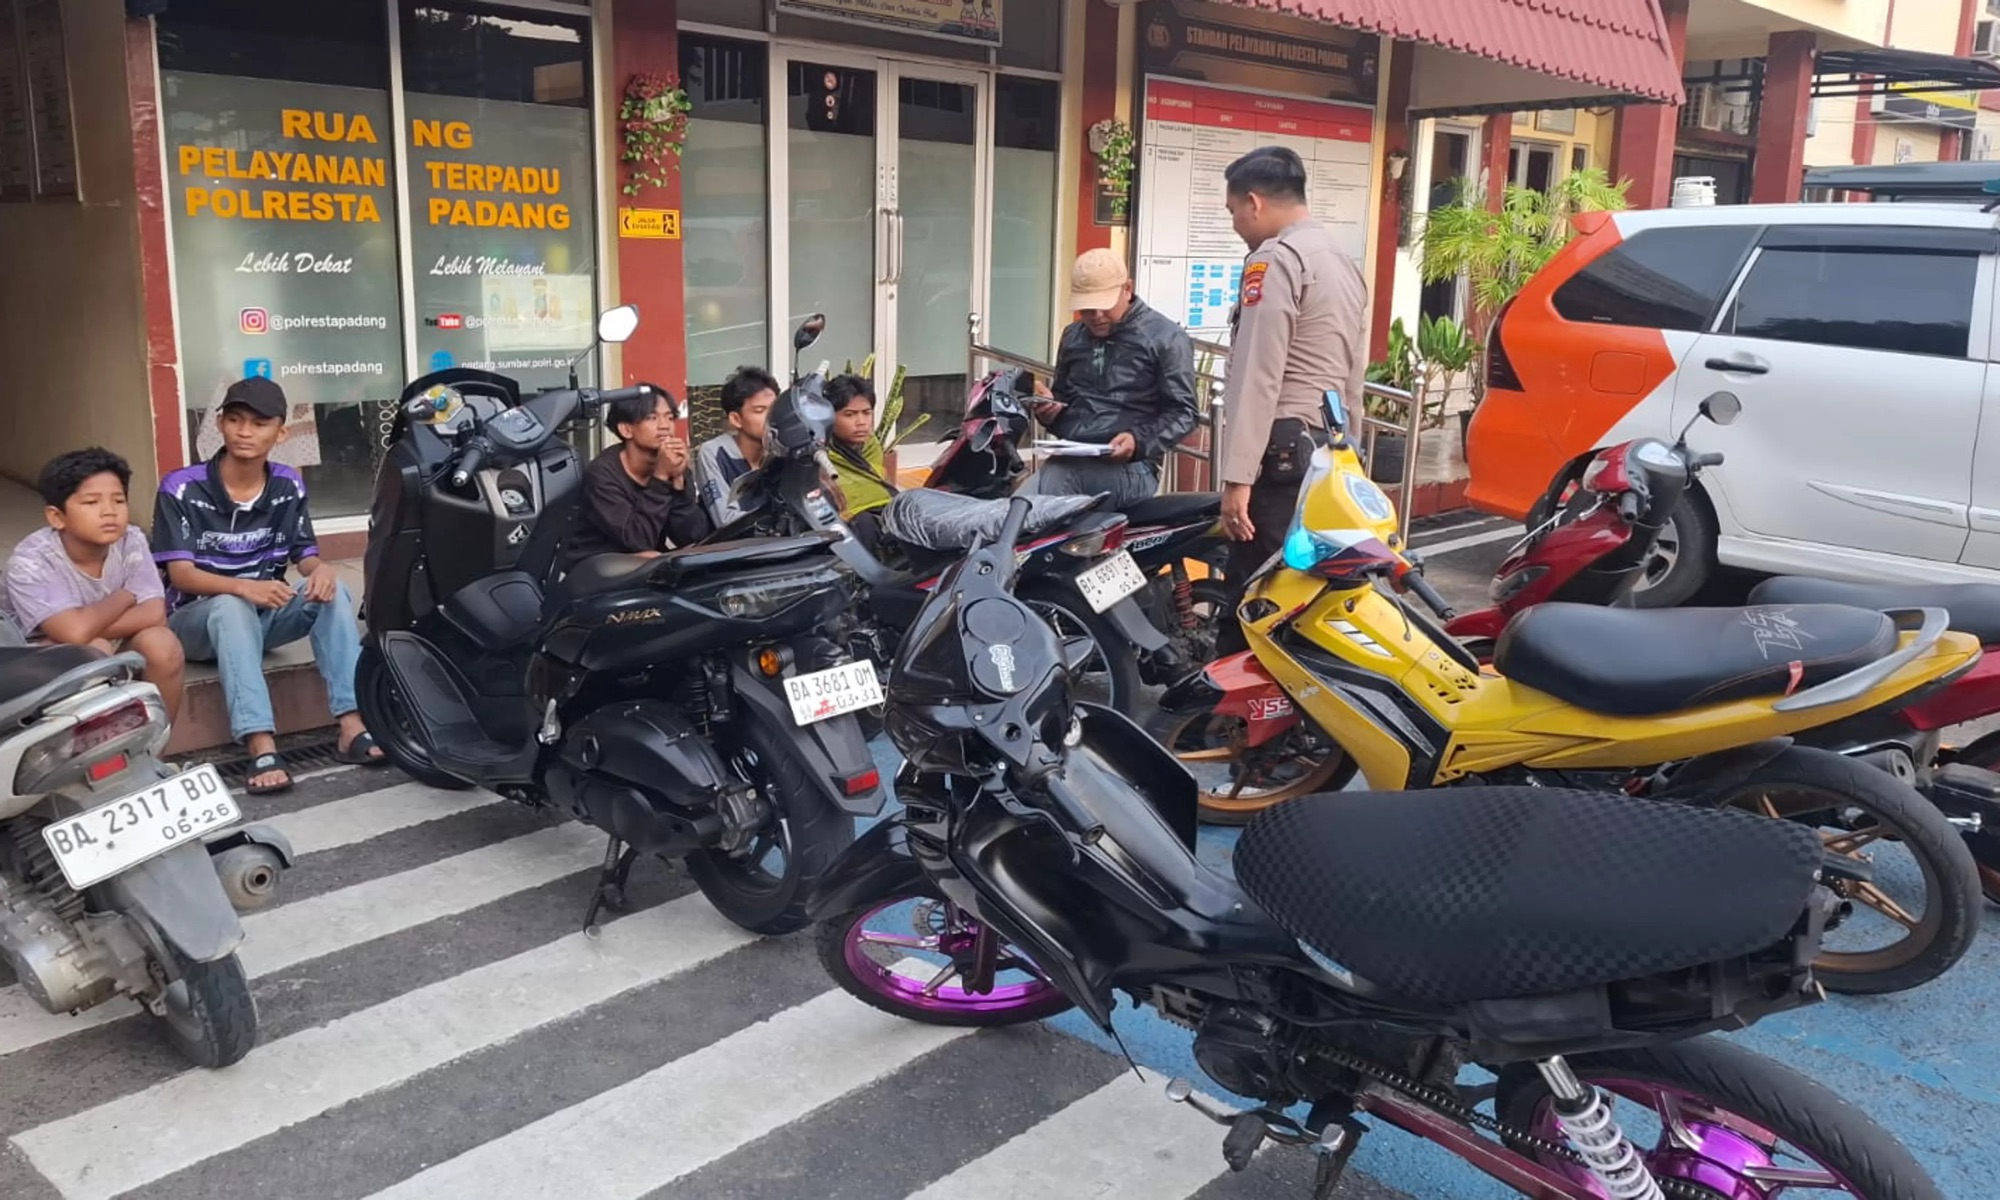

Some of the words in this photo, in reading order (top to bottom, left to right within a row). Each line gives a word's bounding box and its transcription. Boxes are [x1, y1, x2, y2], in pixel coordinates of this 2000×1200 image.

[282, 109, 377, 143] RUA
[413, 119, 473, 149] NG
[178, 145, 386, 187] PELAYANAN
[425, 161, 561, 195] TERPADU
[185, 187, 381, 222] POLRESTA
[429, 198, 571, 230] PADANG
[235, 252, 289, 273] Lebih
[294, 253, 353, 274] Dekat
[430, 255, 472, 275] Lebih
[476, 256, 545, 276] Melayani
[270, 315, 387, 331] @polrestapadang
[281, 361, 383, 377] polrestapadang
[790, 681, 810, 701] BA
[812, 671, 850, 697] 3681
[1247, 697, 1293, 720] YSS
[52, 821, 96, 855] BA
[102, 788, 170, 835] 2317
[180, 771, 218, 801] BD
